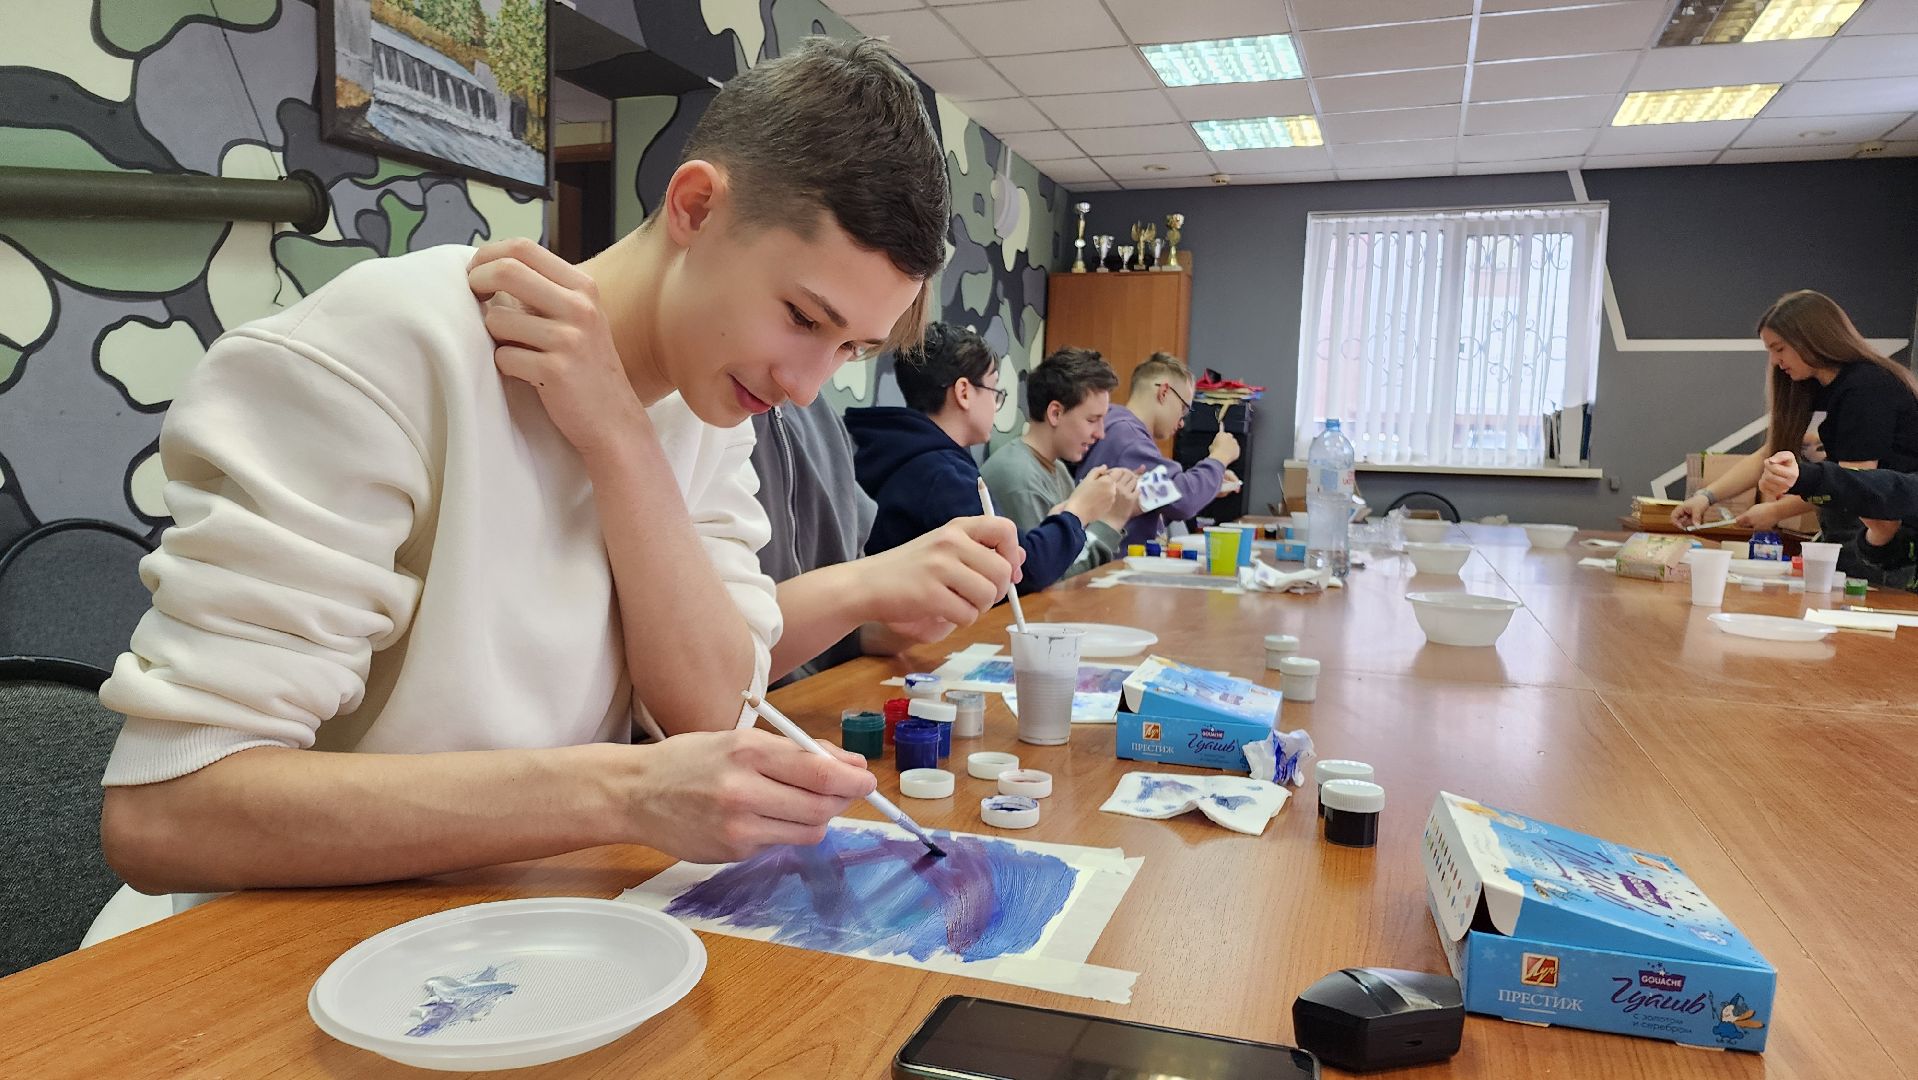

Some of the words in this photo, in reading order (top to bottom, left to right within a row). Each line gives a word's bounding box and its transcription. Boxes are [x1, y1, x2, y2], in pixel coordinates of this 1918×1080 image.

[1131, 742, 1174, 753] ПРЕСТИЖ
[1641, 975, 1682, 987] GOUACHE
[1498, 989, 1584, 1012] ПРЕСТИЖ
